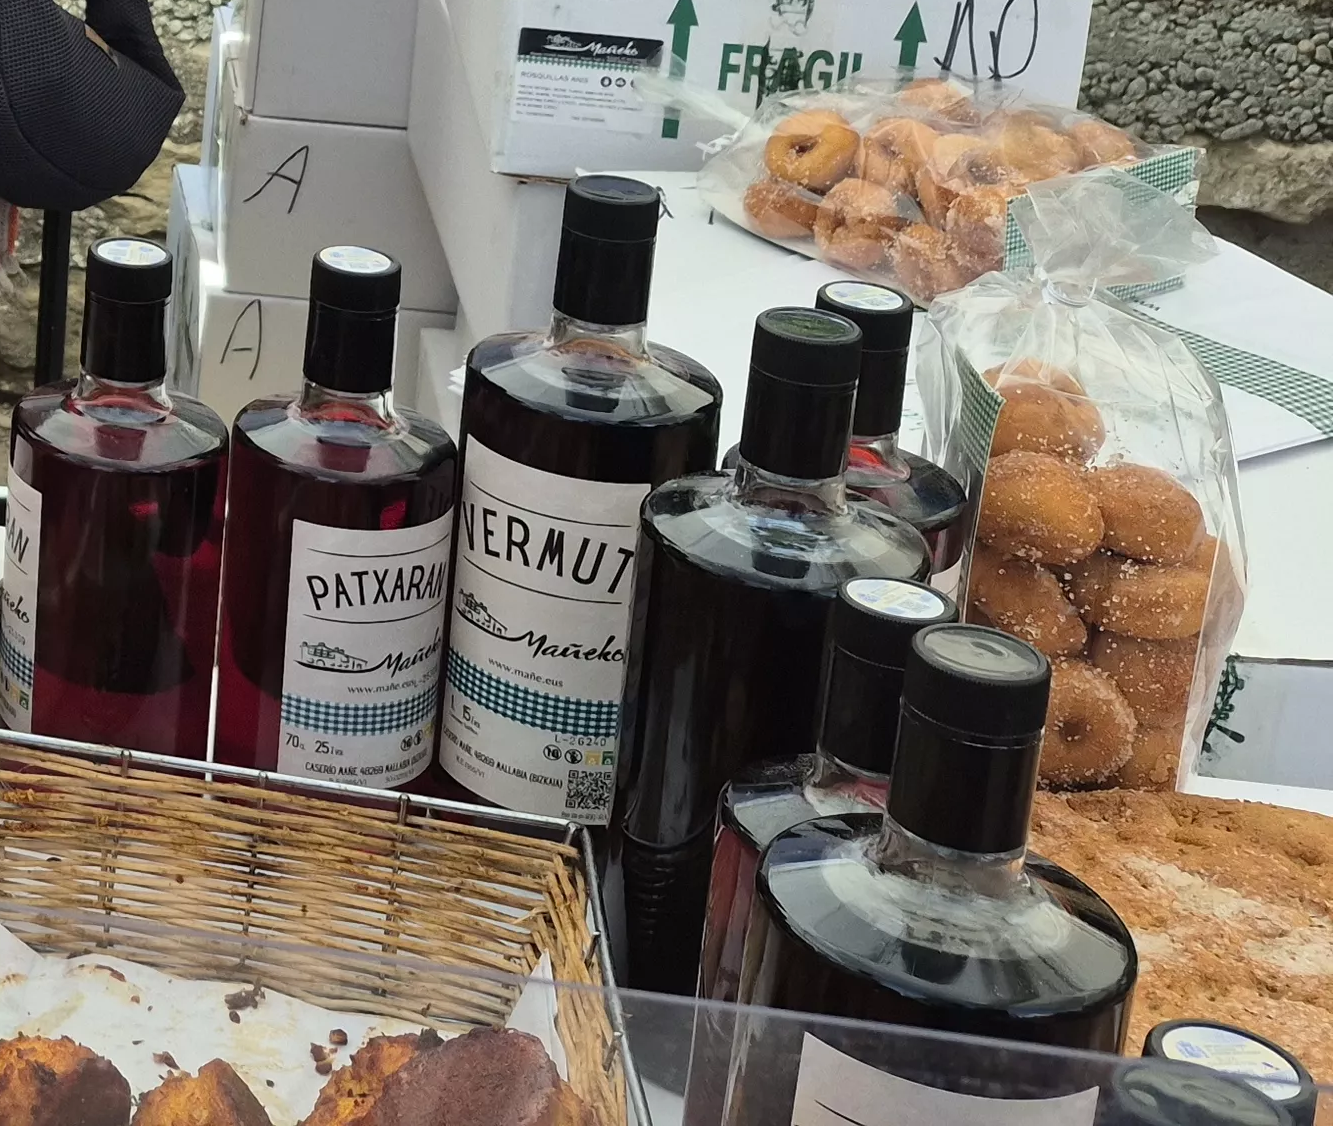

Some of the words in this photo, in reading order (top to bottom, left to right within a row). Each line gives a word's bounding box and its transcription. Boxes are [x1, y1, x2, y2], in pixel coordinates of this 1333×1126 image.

[243, 145, 309, 214] A
[220, 298, 263, 381] A
[462, 500, 635, 594] VERMUT
[306, 561, 447, 611] PATXARAN
[379, 627, 442, 678] Mañek
[520, 630, 625, 662] Mañeko
[487, 657, 565, 688] www.mañe.eus
[285, 733, 300, 748] 70
[495, 761, 528, 781] MALLABIA
